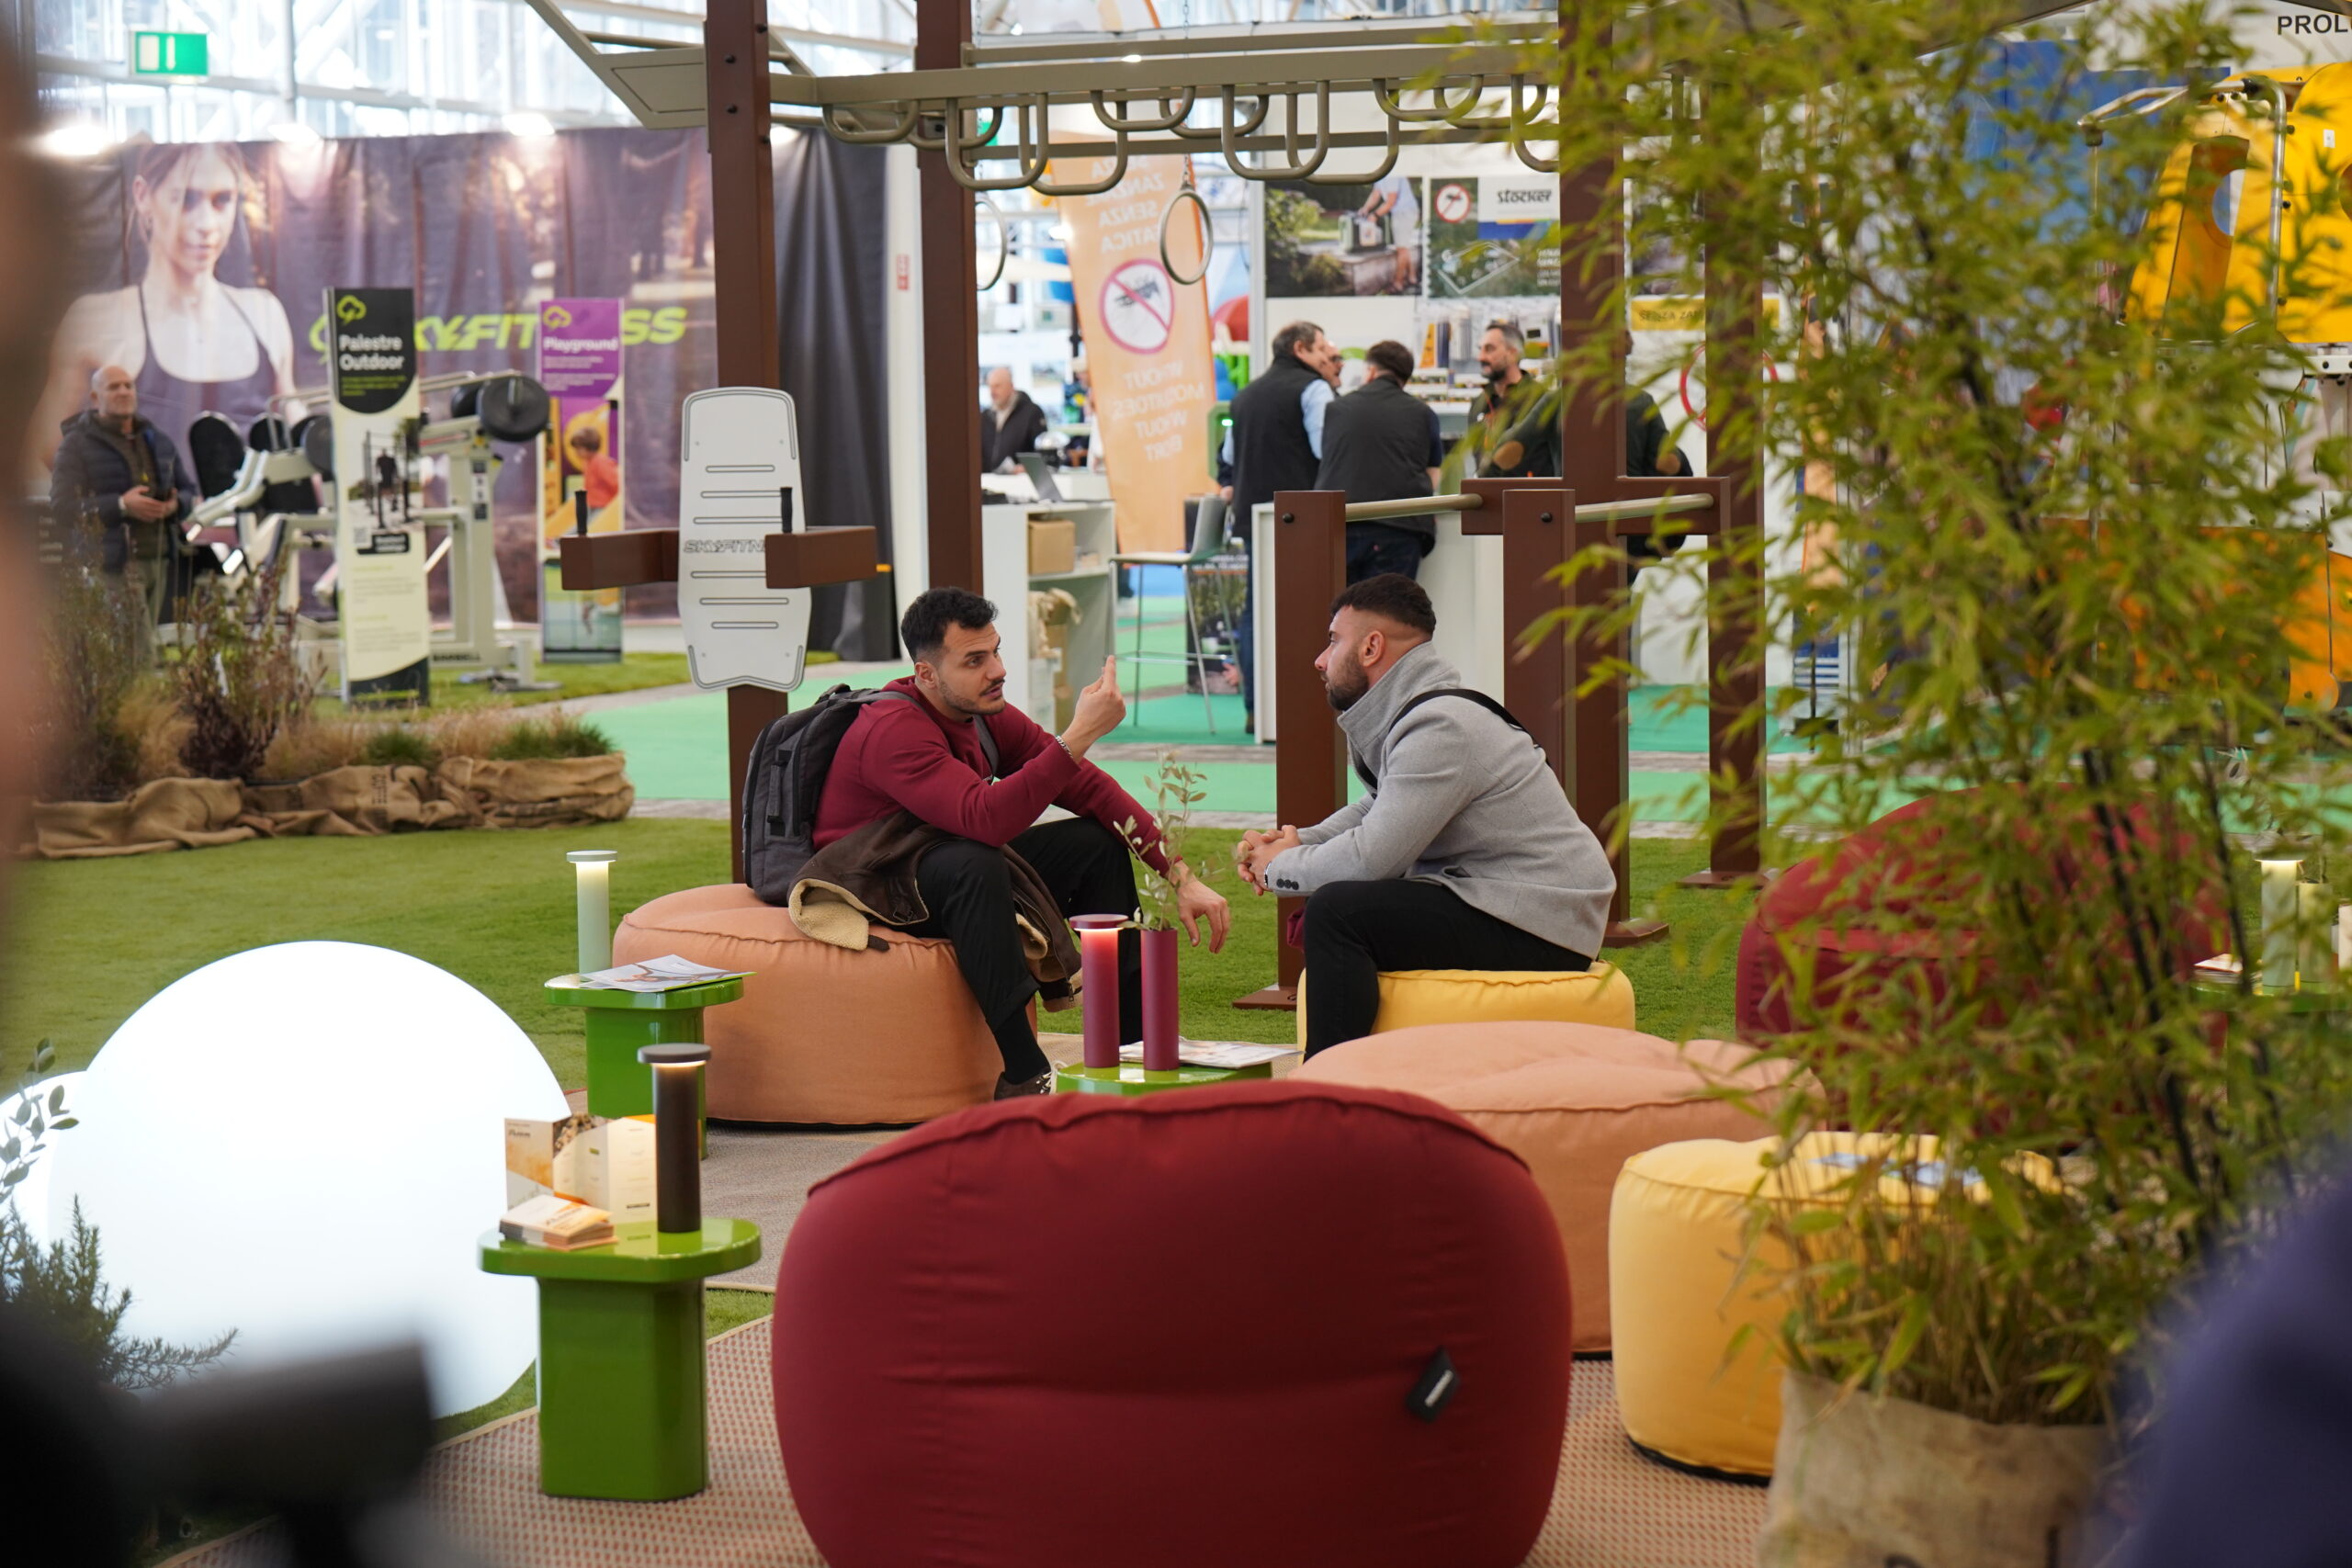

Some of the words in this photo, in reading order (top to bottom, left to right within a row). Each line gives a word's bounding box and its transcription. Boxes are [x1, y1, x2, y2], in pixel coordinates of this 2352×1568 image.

[2278, 14, 2352, 35] PROL
[339, 334, 403, 351] Palestre
[544, 337, 619, 354] Playground
[339, 353, 404, 371] Outdoor
[684, 539, 765, 553] SKYFITN
